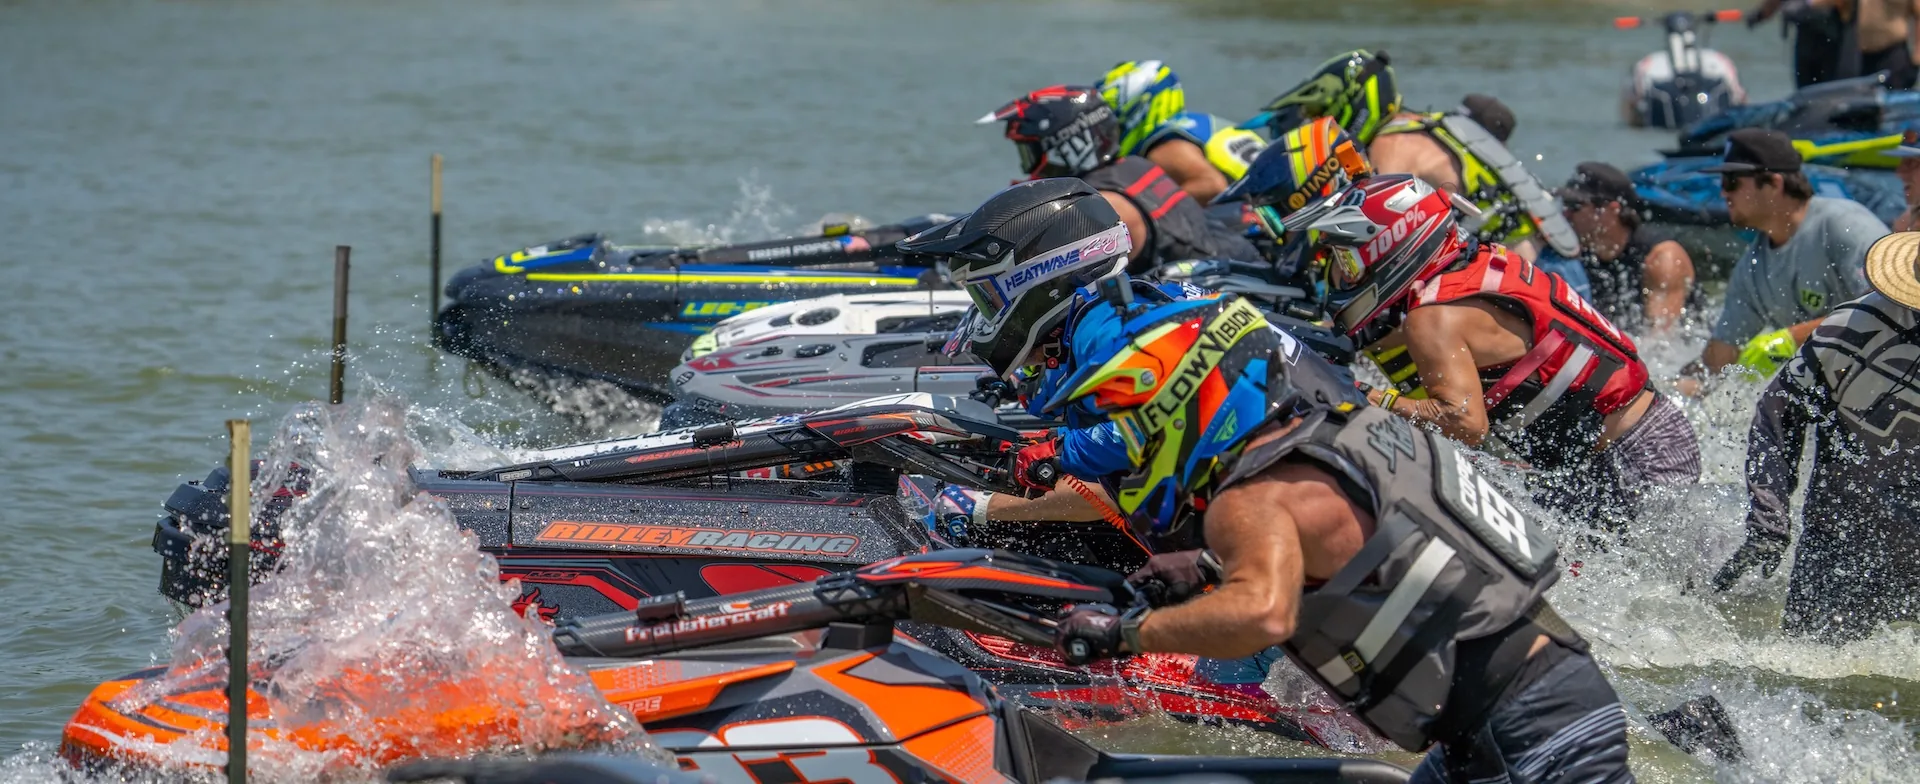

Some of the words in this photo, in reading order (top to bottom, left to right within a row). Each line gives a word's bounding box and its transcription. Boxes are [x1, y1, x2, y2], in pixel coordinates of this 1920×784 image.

[1366, 204, 1426, 262] 100%
[1005, 249, 1080, 292] HEATWAVE
[1477, 475, 1532, 559] 93
